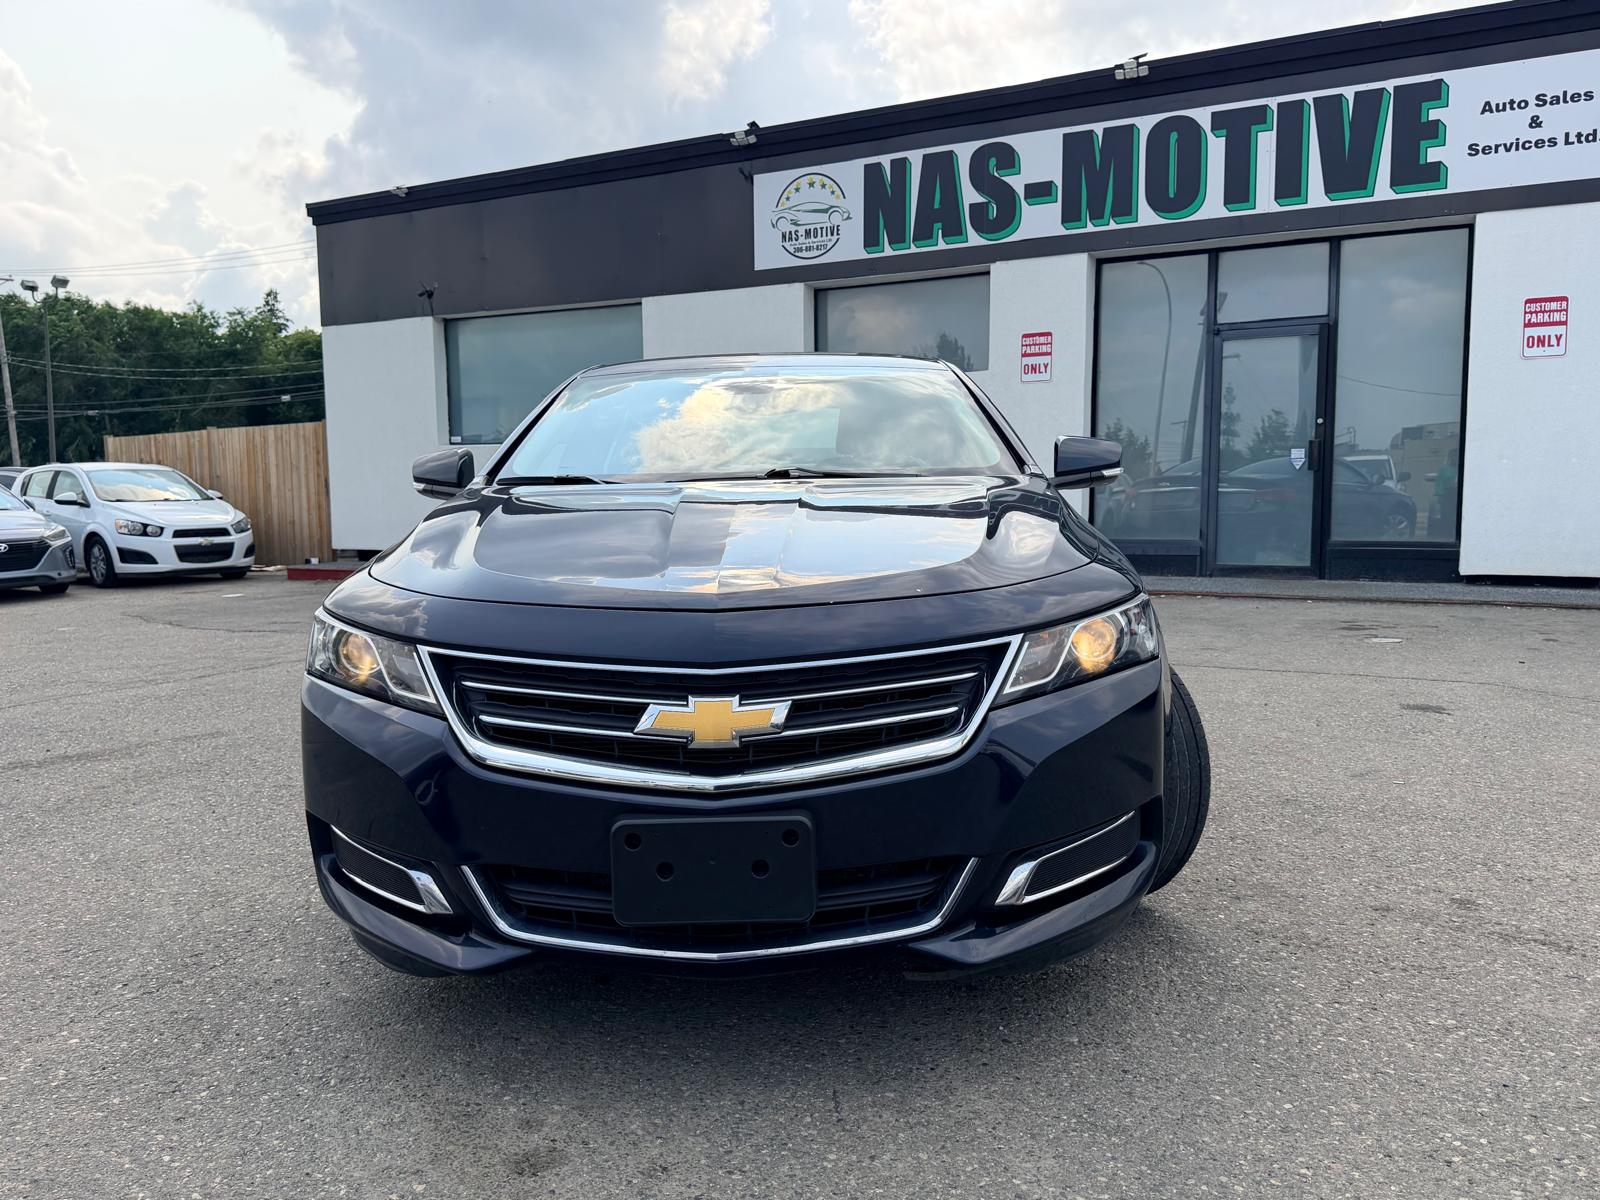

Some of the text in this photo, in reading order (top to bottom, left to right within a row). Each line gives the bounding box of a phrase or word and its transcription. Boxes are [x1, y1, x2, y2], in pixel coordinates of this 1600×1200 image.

[1480, 90, 1595, 115] Auto Sales
[1528, 114, 1544, 129] &
[1467, 128, 1600, 157] Services Ltd
[864, 78, 1450, 254] NAS-MOTIVE
[781, 224, 841, 243] NAS-MOTIVE
[1525, 301, 1567, 312] CUSTOMER
[1525, 311, 1567, 324] PARKING
[1022, 336, 1051, 345] CUSTOMER
[1526, 334, 1563, 349] ONLY
[1022, 344, 1051, 354] PARKING
[1023, 362, 1049, 375] ONLY
